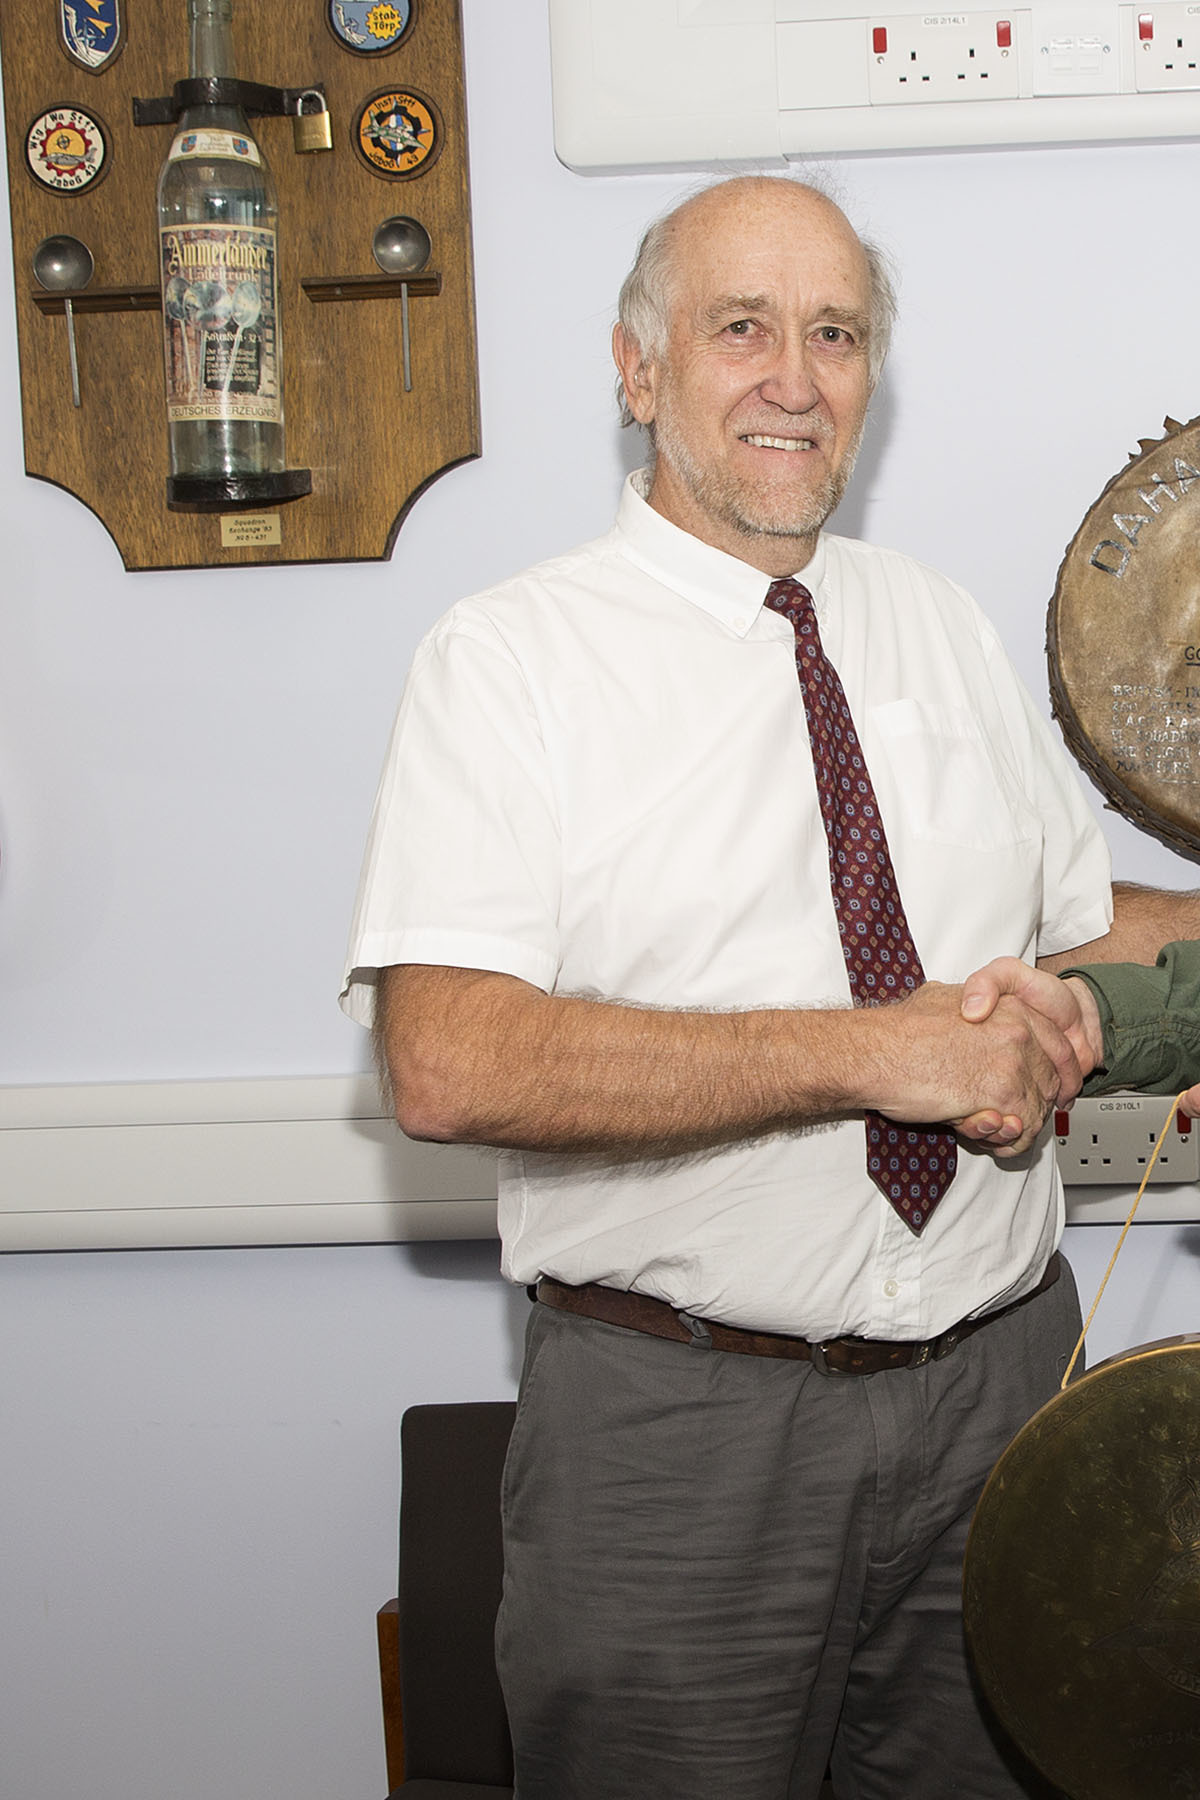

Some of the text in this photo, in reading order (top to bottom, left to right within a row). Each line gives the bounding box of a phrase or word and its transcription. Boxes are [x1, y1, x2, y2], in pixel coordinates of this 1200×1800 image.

[372, 10, 396, 21] Stab
[1187, 7, 1200, 15] CIS
[923, 16, 966, 26] CIS 2/14L1
[85, 164, 97, 177] 43
[171, 406, 277, 418] DEUTSCHES ERZEUGNIS
[1100, 1103, 1114, 1111] CIS
